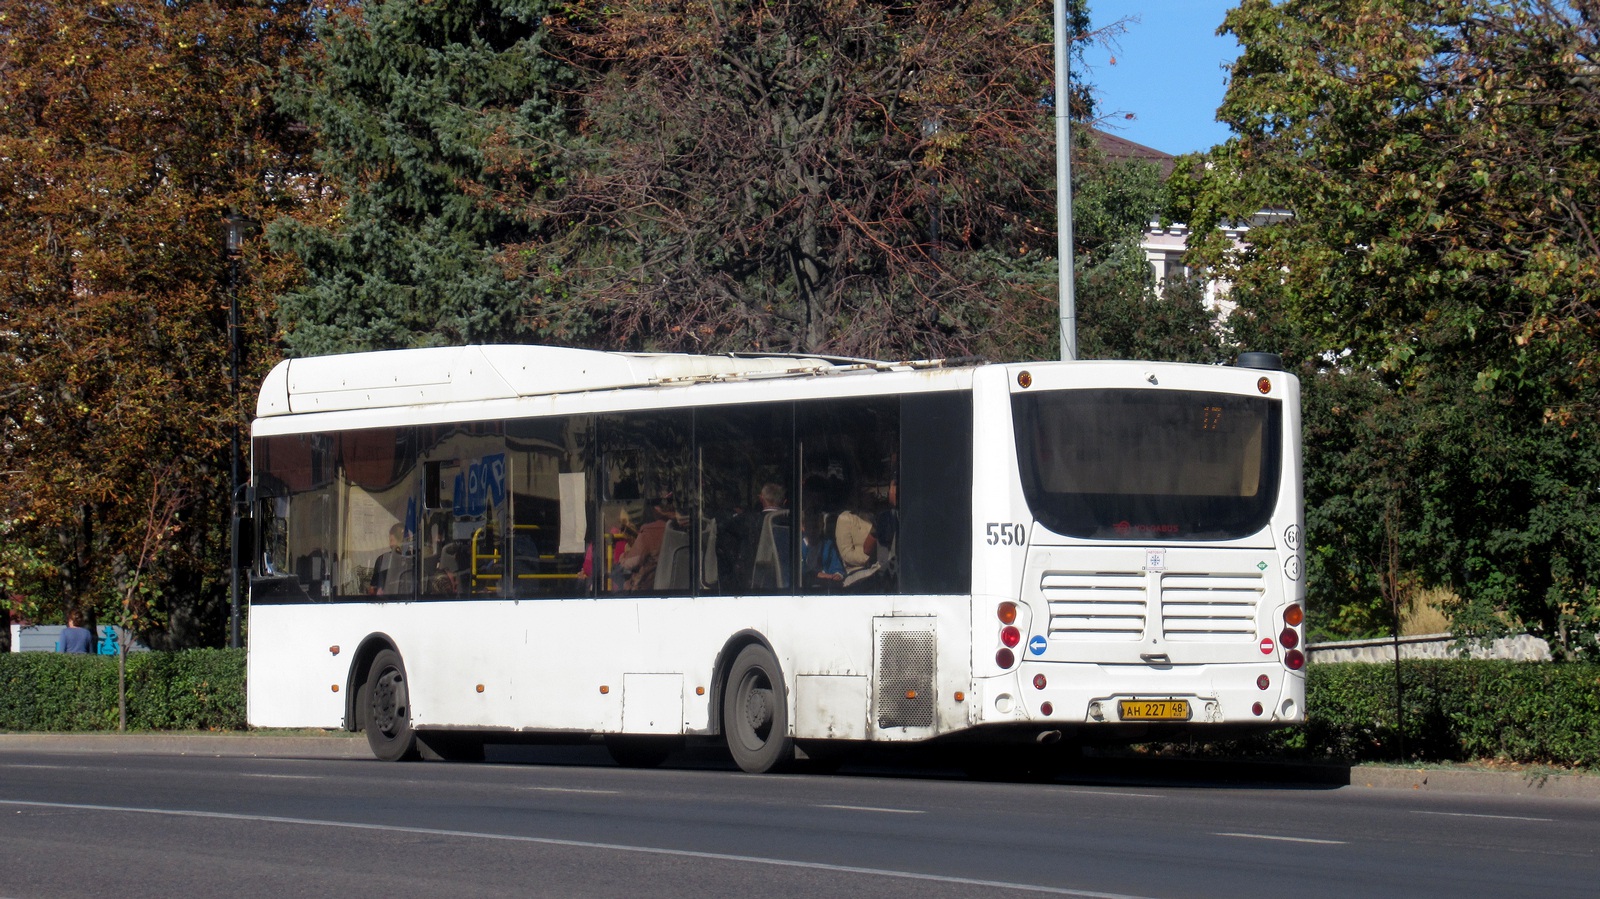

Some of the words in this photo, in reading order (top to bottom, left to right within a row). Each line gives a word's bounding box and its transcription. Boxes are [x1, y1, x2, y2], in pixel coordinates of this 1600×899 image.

[986, 522, 1026, 546] 550
[1287, 530, 1300, 543] 60
[1145, 703, 1166, 716] 227
[1171, 703, 1183, 713] 48
